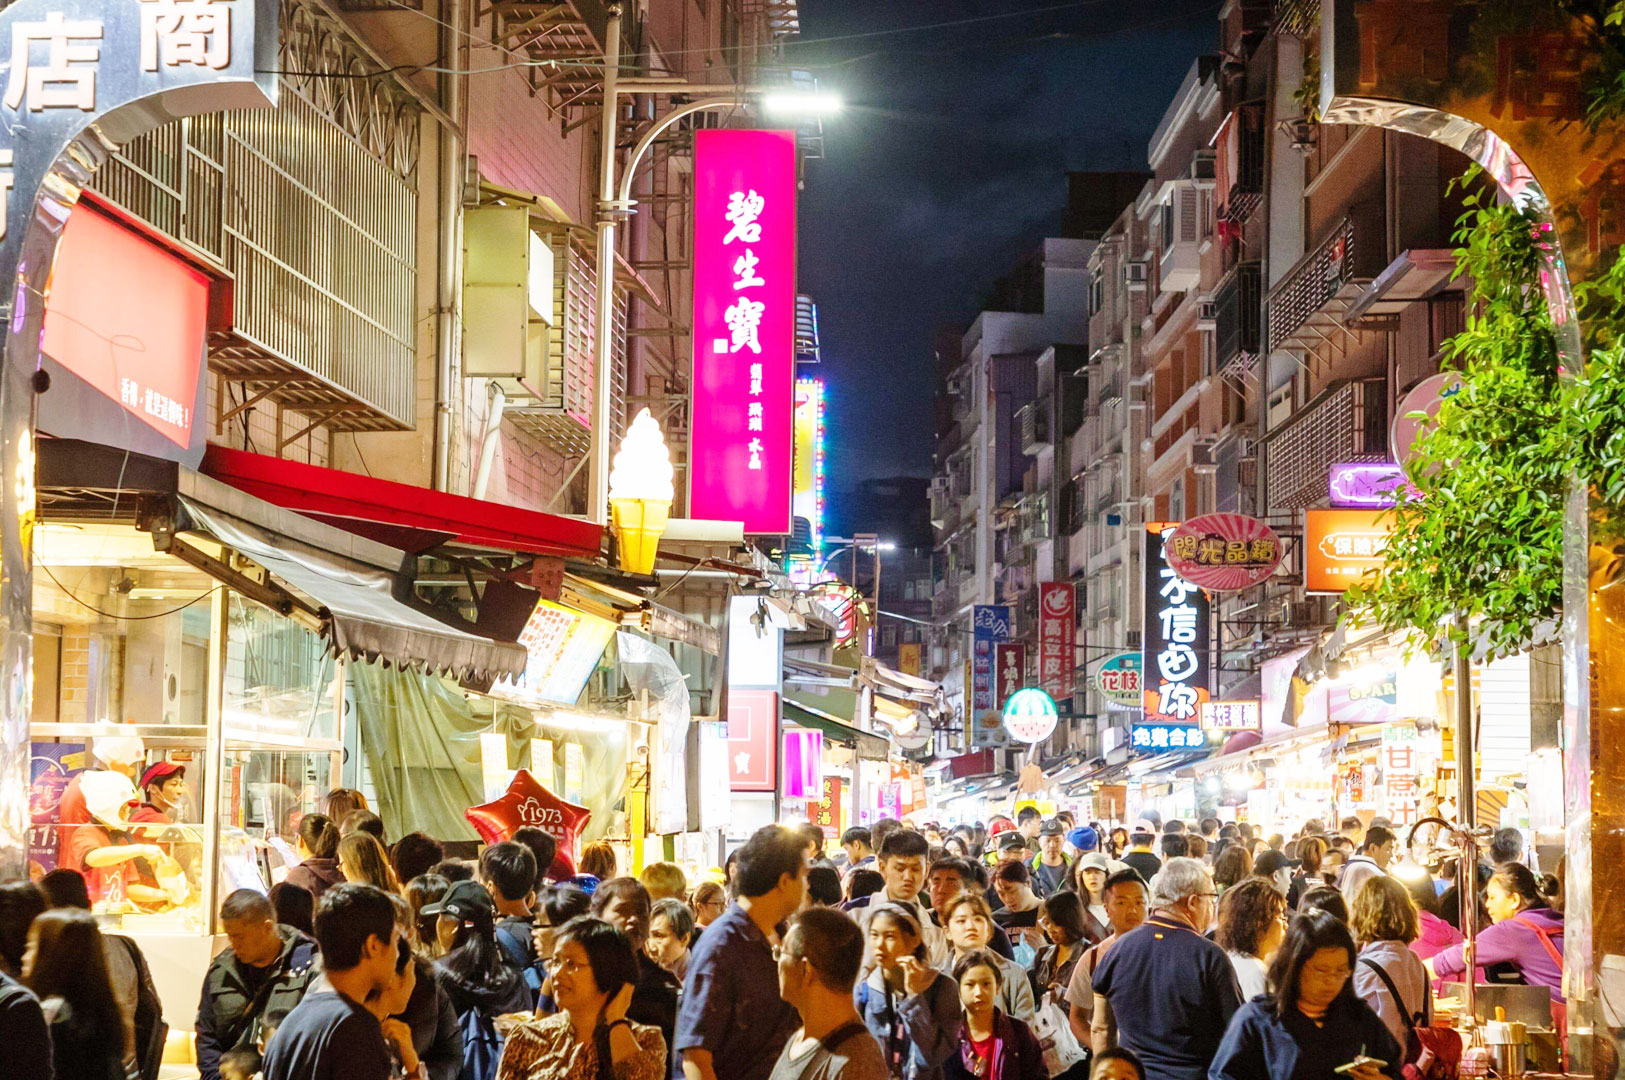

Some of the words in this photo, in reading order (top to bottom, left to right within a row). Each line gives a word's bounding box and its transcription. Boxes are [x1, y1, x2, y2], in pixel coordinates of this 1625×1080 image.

[723, 190, 765, 353] 碧生寶
[1173, 535, 1276, 565] 閃光晶鑽
[1349, 683, 1397, 701] SPAR
[1132, 726, 1204, 748] 免費合影
[1385, 745, 1416, 825] 甘蔗汁
[530, 807, 562, 825] 1973
